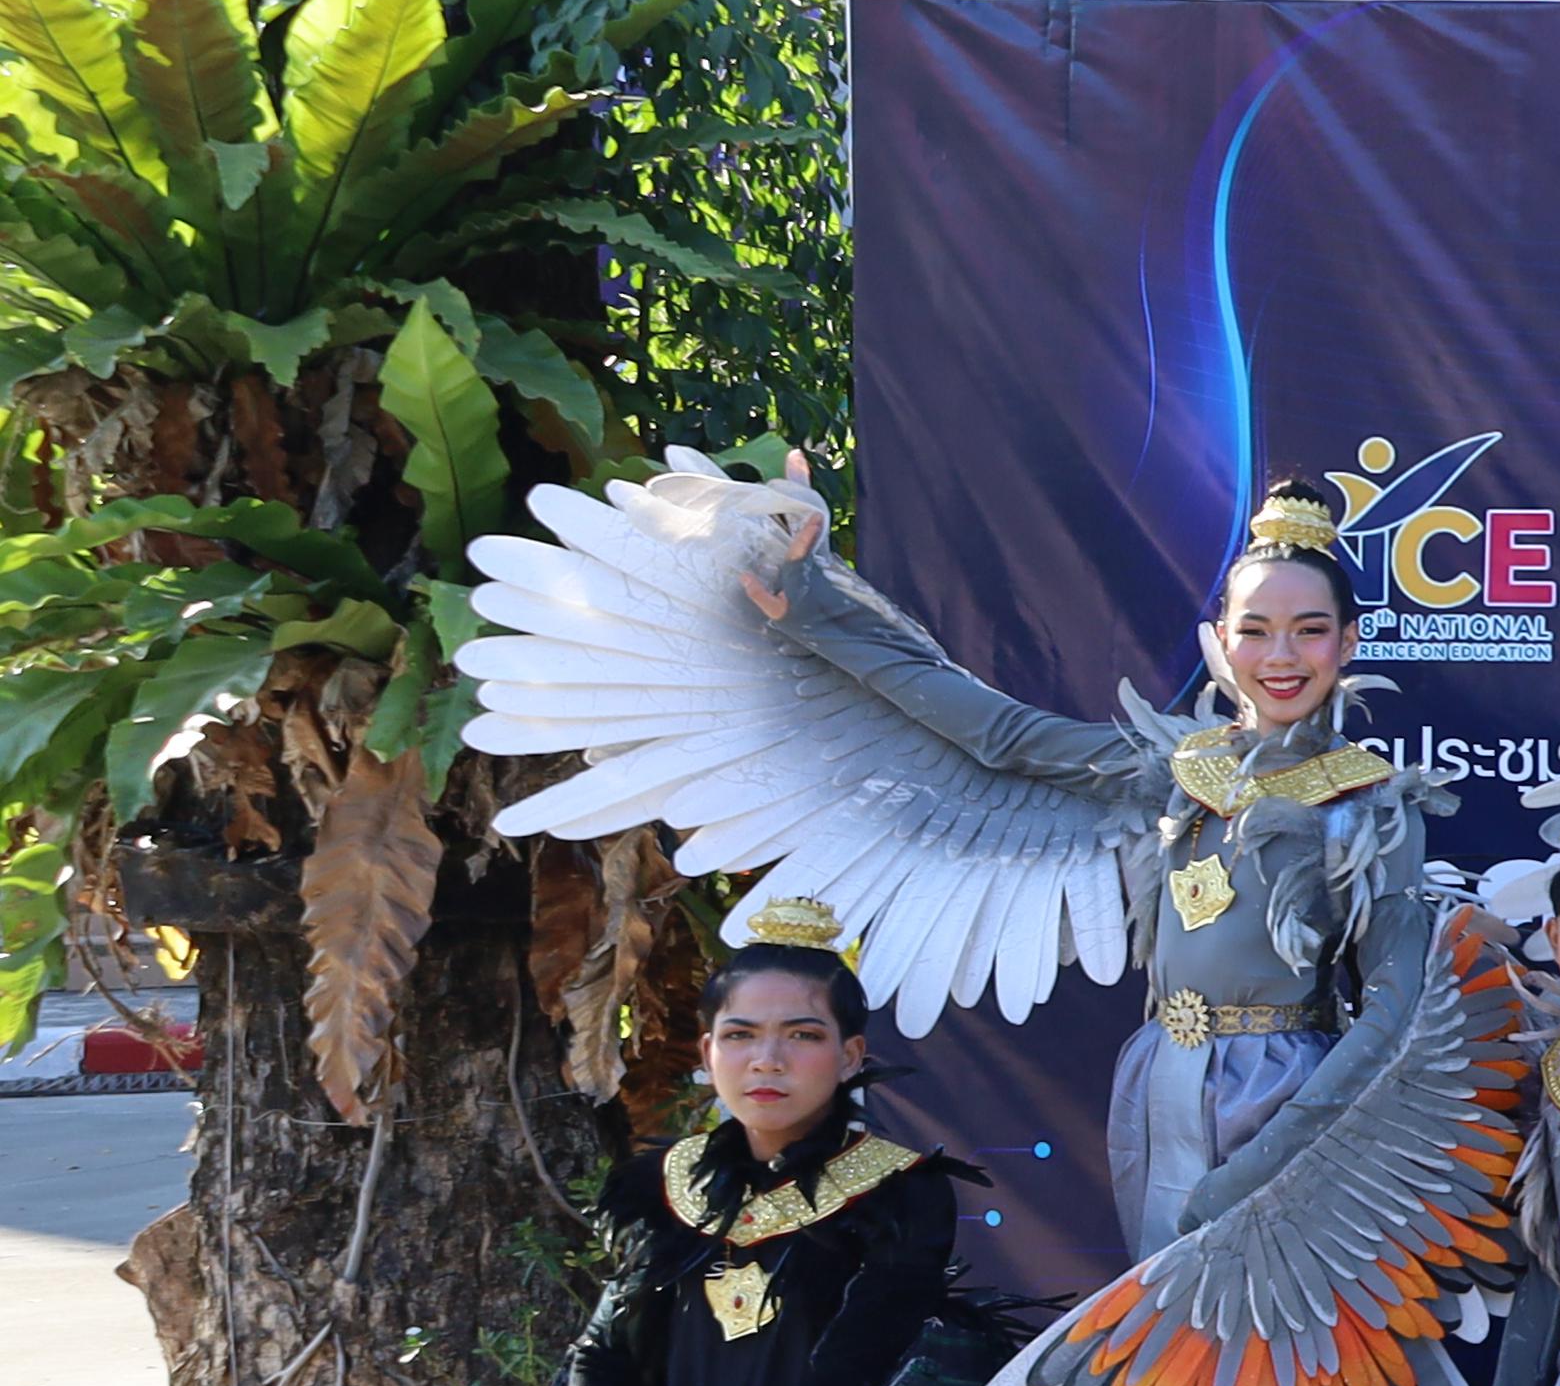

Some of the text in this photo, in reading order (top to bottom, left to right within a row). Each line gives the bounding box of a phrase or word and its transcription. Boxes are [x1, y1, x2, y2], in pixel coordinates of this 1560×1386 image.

[1401, 614, 1553, 640] NATIONAL
[1352, 642, 1552, 661] RENCE ON EDUCATION
